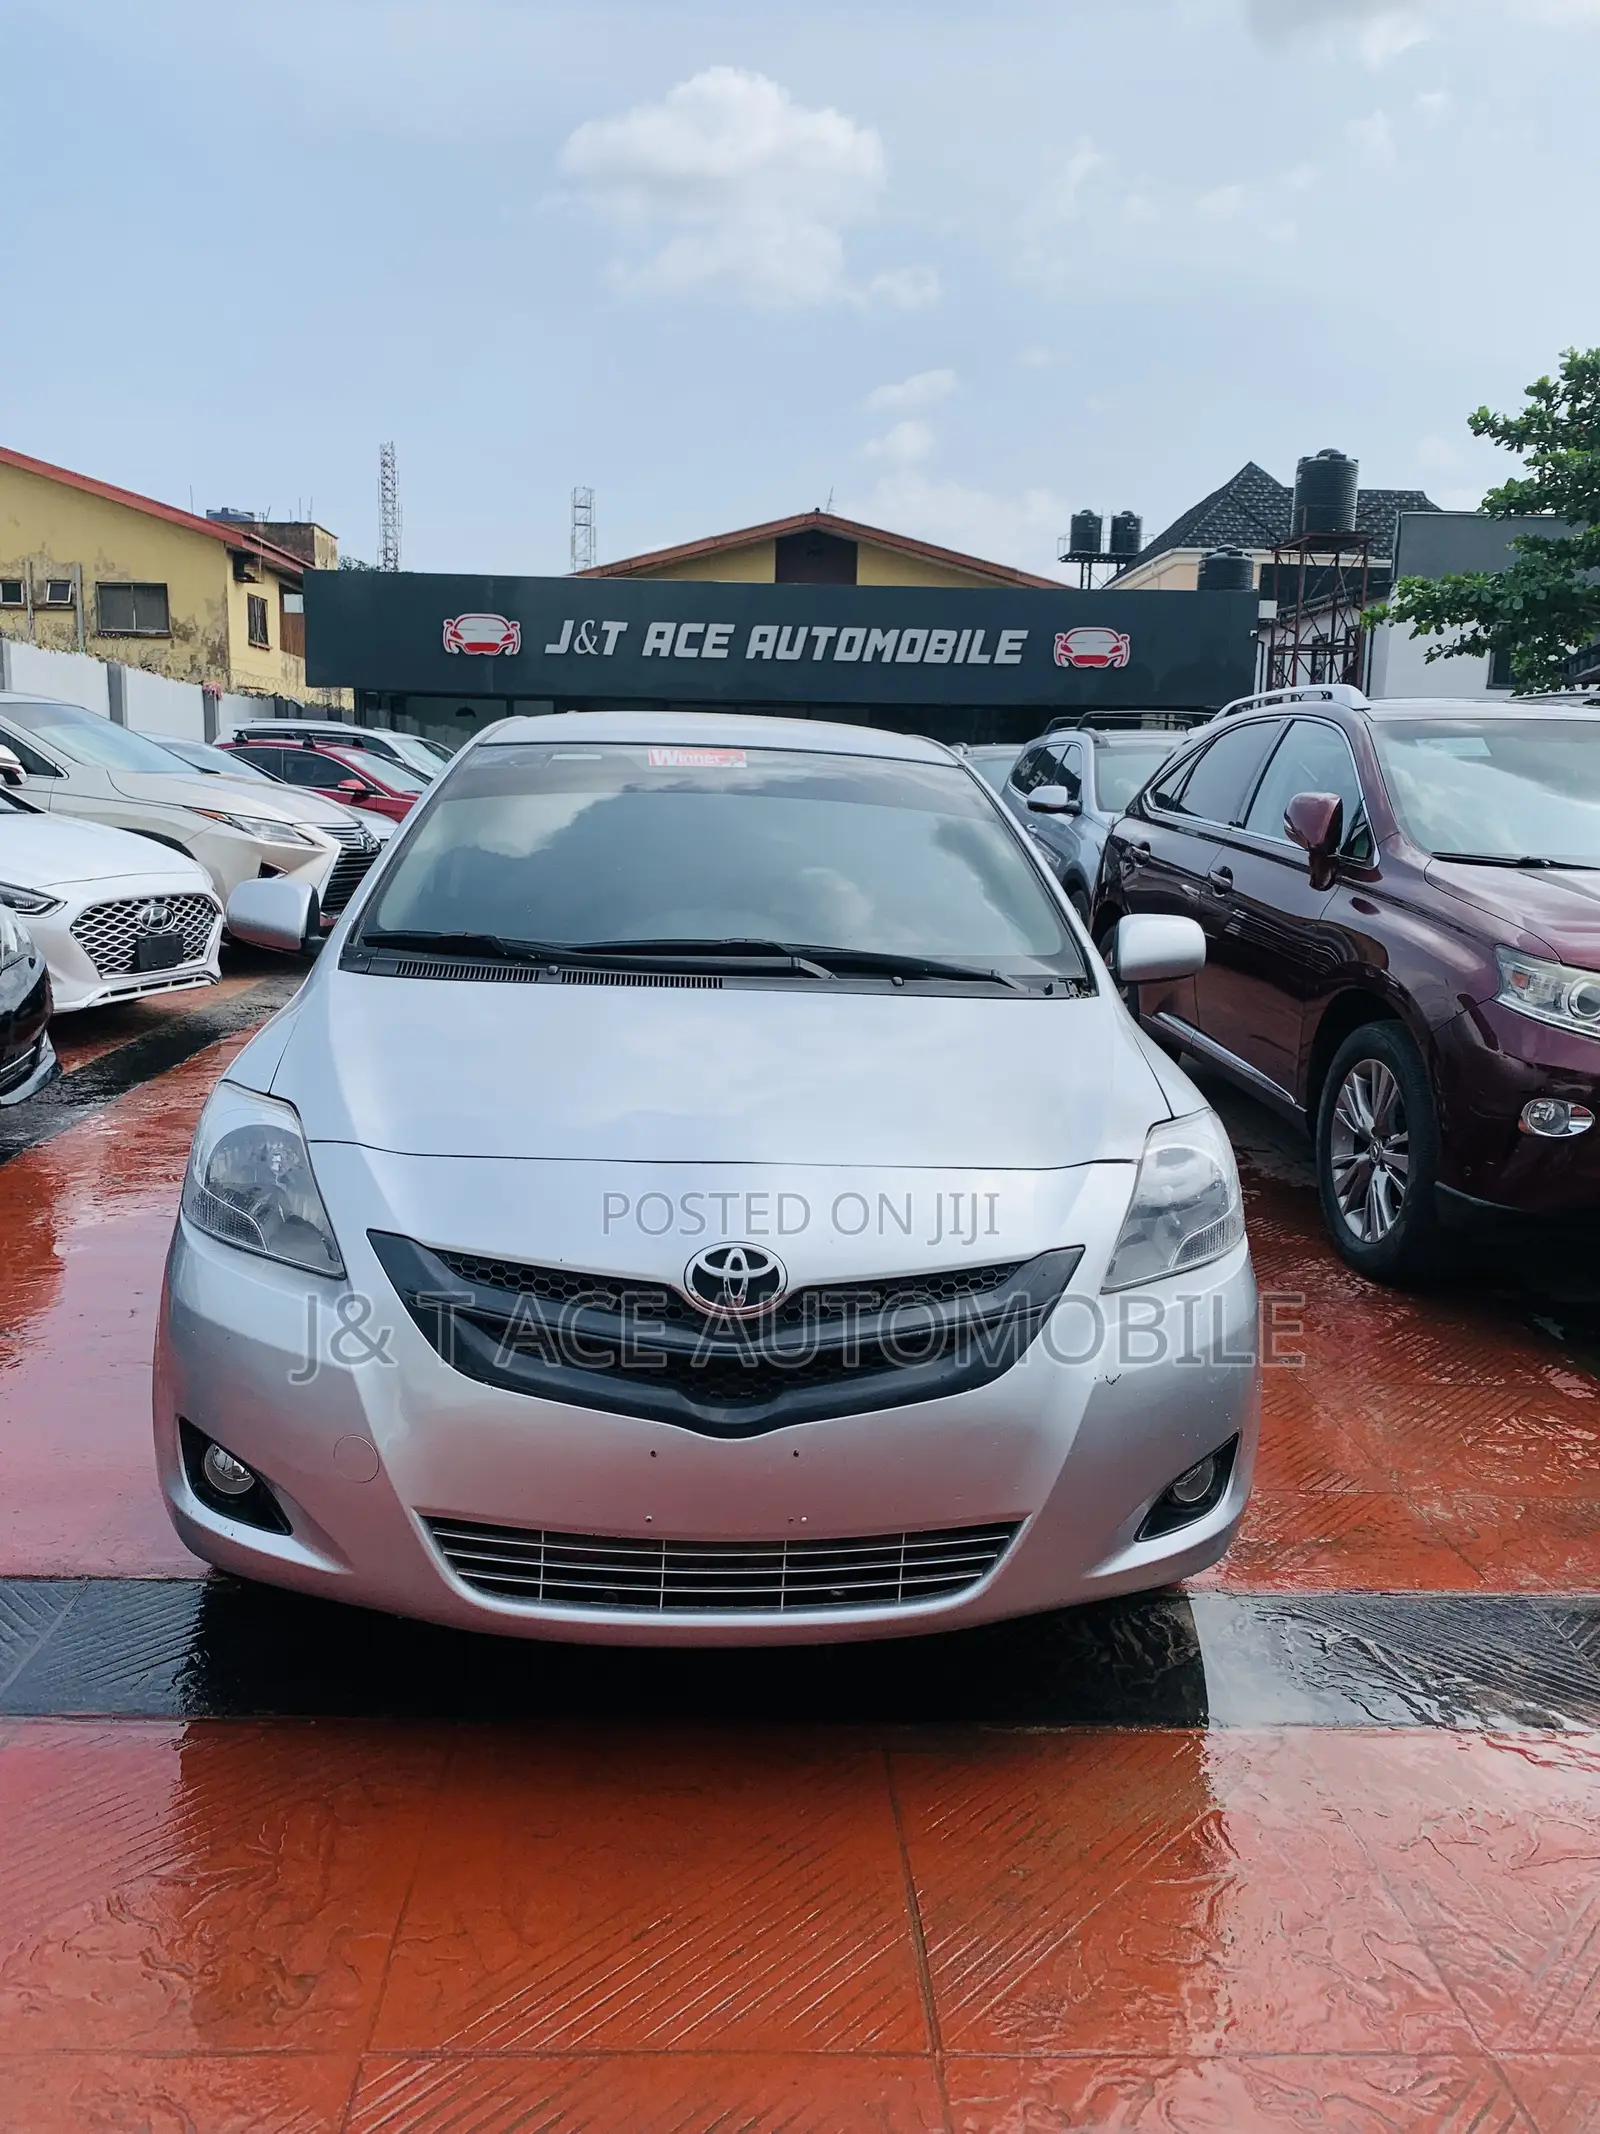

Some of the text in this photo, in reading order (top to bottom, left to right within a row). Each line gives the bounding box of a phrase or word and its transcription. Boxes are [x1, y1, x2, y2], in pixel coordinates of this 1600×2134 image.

[545, 619, 1029, 664] J&T ACE AUTOMOBILE
